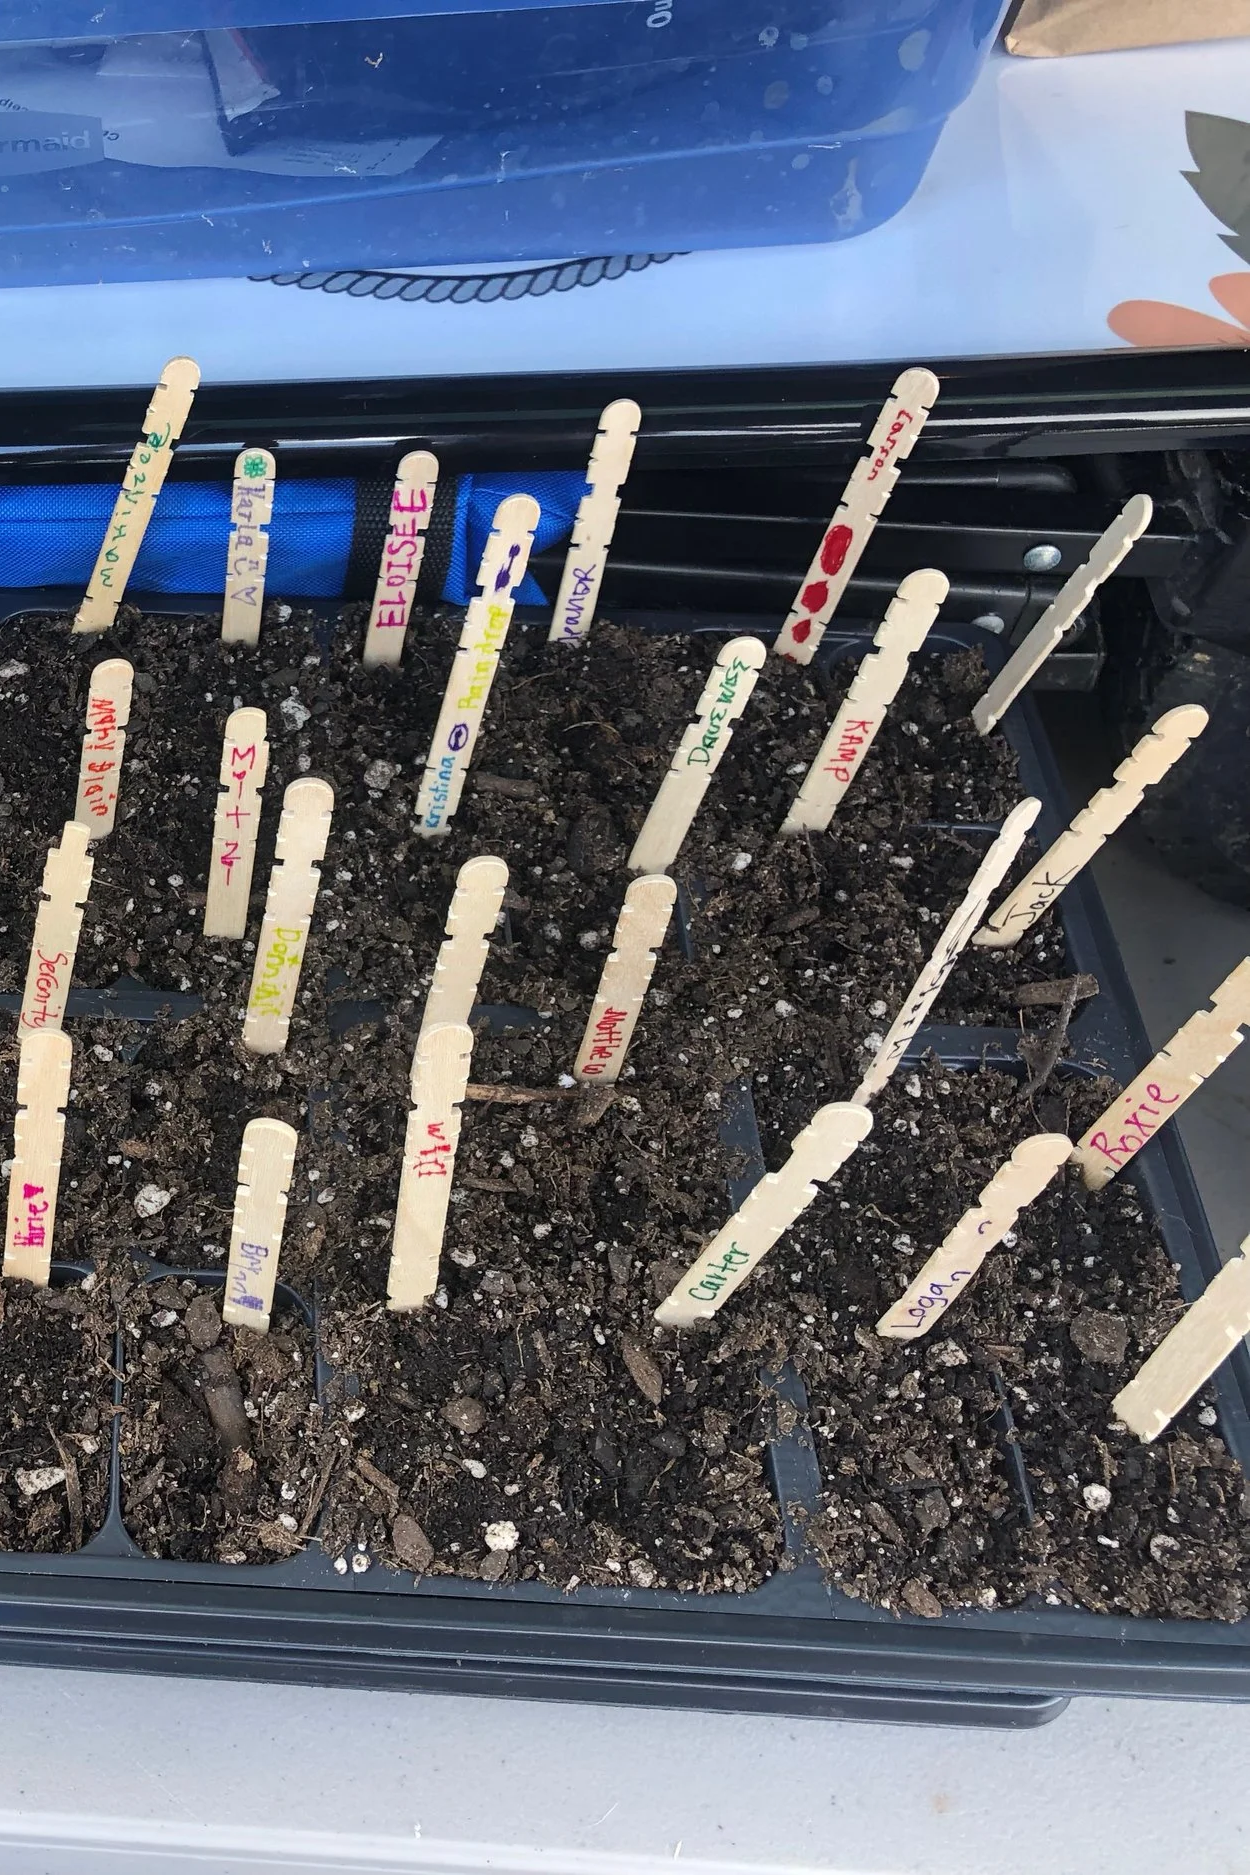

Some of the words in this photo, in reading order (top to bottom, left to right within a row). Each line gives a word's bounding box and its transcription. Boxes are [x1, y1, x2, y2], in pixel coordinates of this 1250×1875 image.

[234, 484, 267, 559] Karla
[823, 719, 874, 783] KAMP
[991, 864, 1079, 933] Jack
[20, 949, 66, 1029] Serenity
[1089, 1080, 1179, 1169] Roxie
[687, 1244, 751, 1303] Carter
[890, 1269, 972, 1330] Logan
